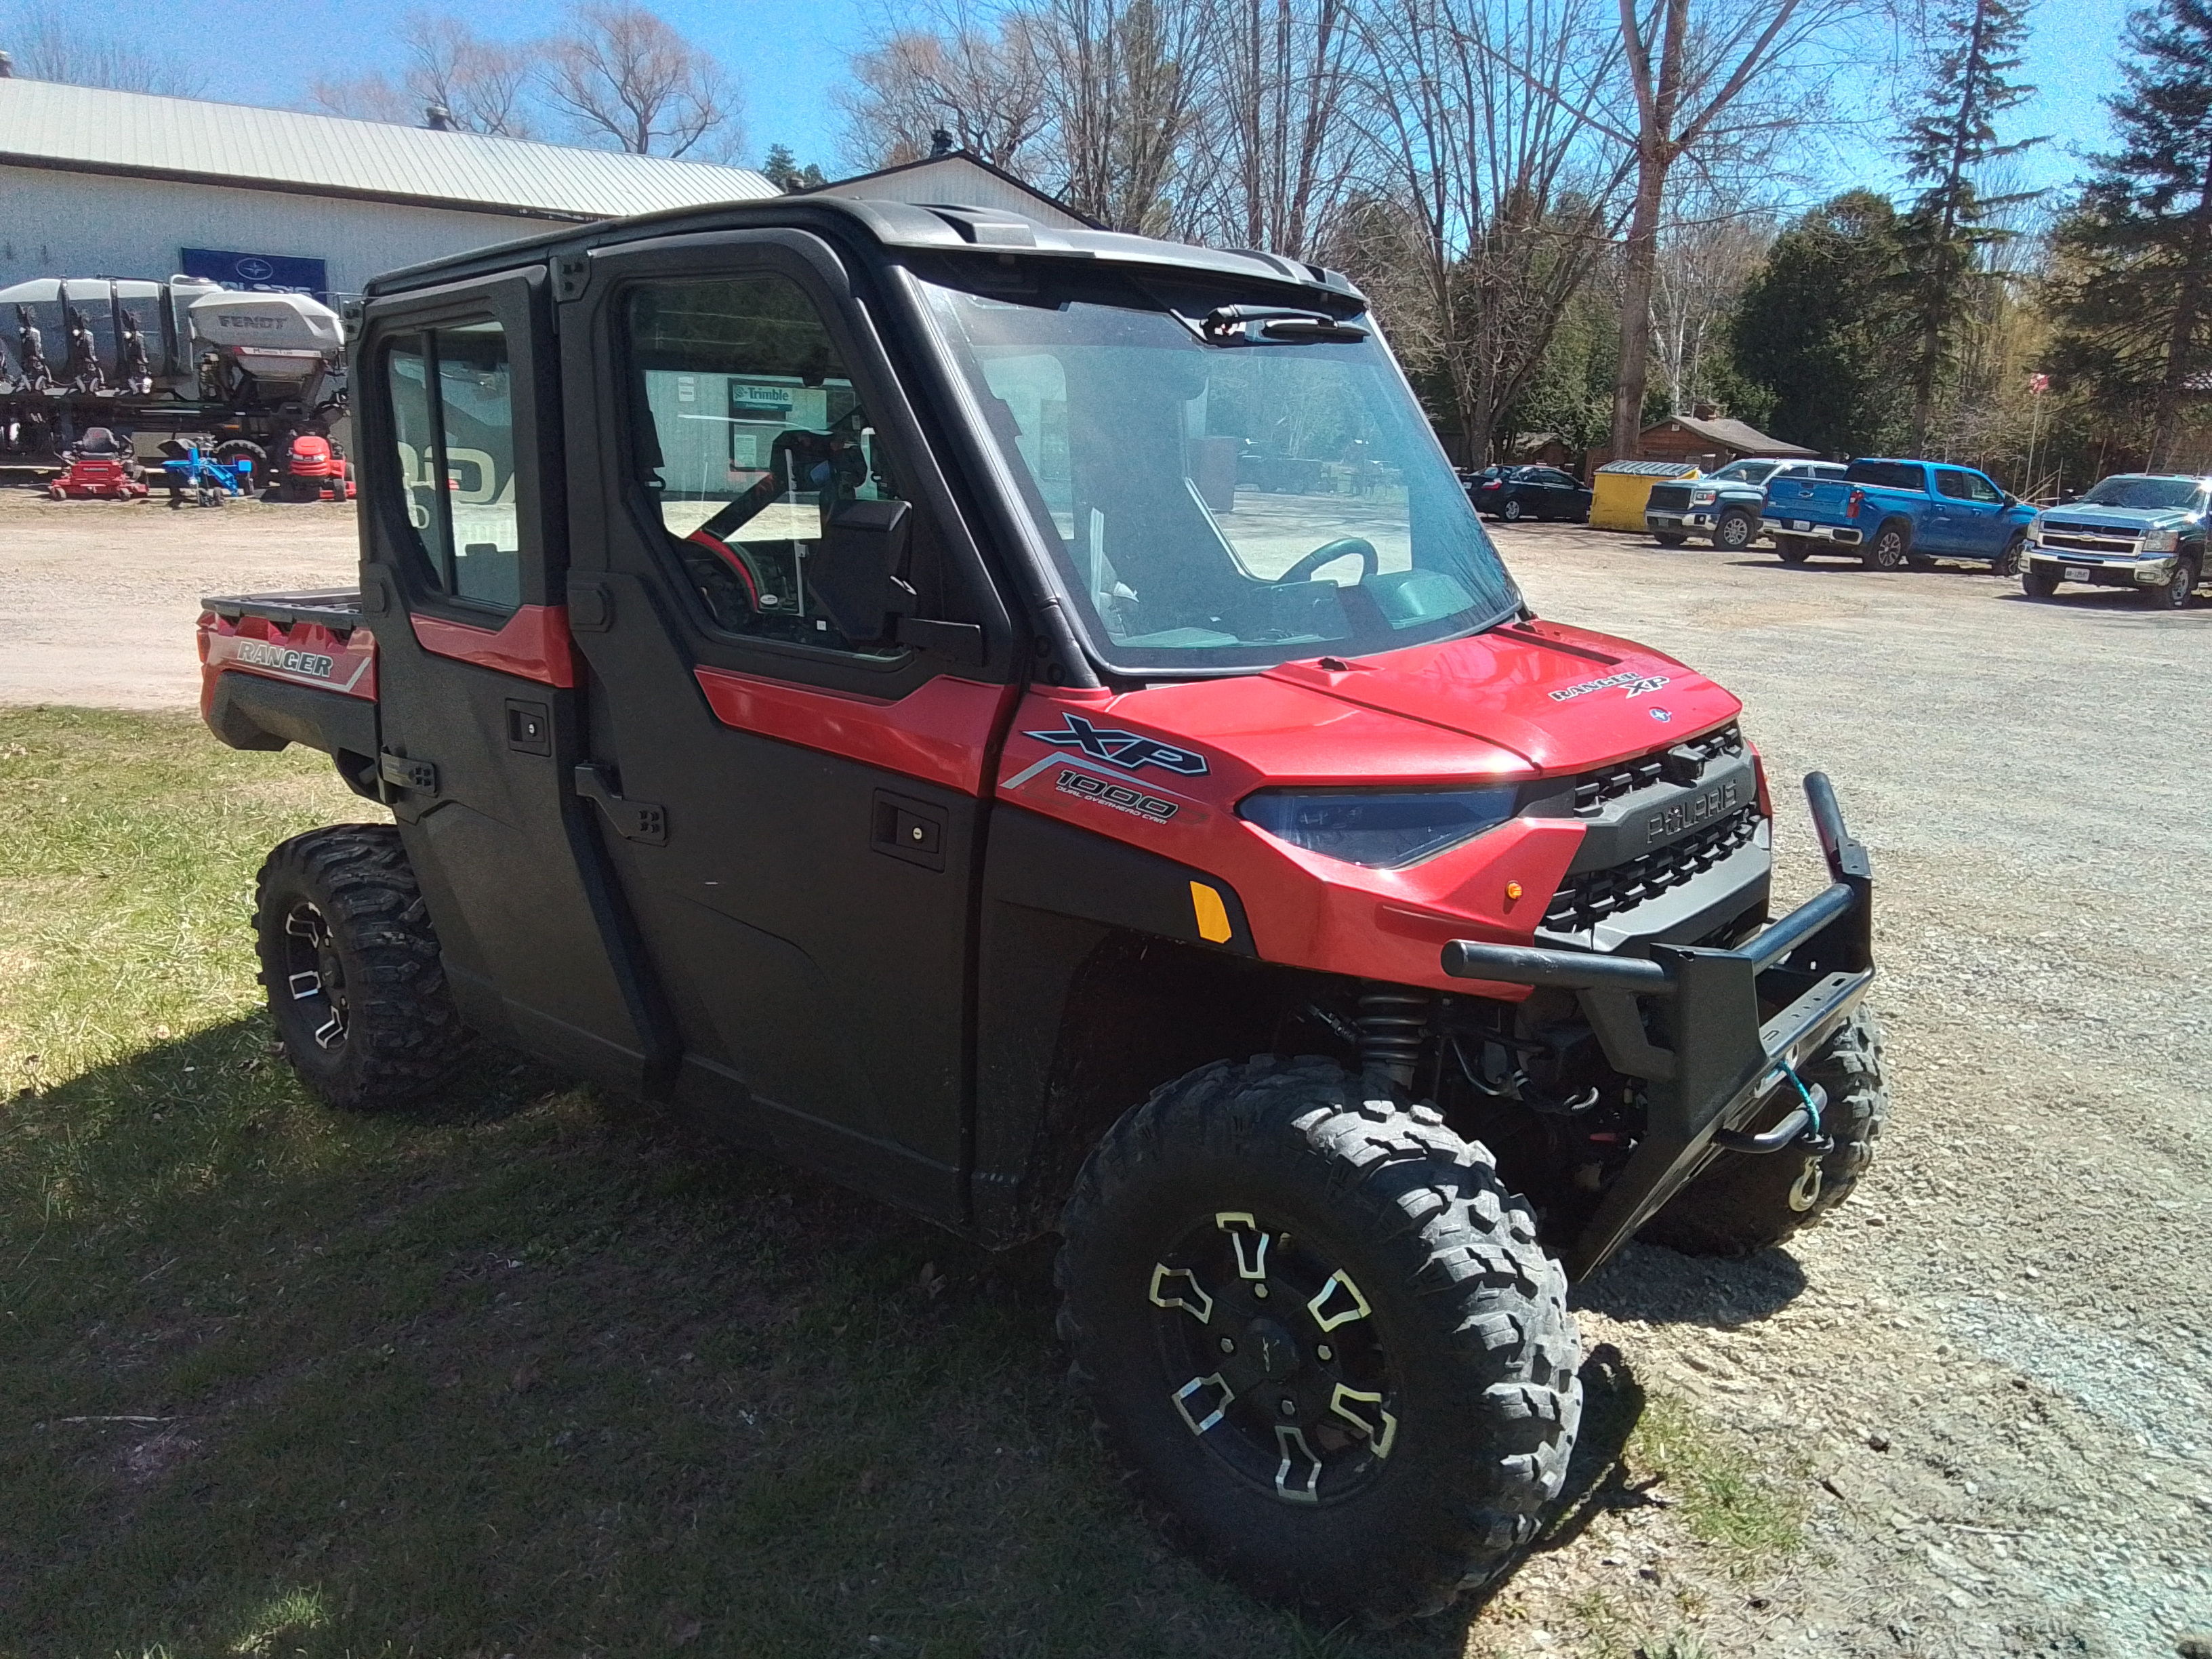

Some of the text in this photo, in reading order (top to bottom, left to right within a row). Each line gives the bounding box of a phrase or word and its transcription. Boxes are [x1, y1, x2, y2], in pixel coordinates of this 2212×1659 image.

[218, 315, 289, 330] FENDT
[747, 387, 789, 401] Trimble
[238, 641, 333, 678] RANGER
[1548, 672, 1643, 701] RANGER
[1618, 676, 1670, 699] XP
[1021, 712, 1211, 775] XP
[1055, 785, 1168, 825] DUAL OVERHEAD CAM
[1056, 769, 1179, 819] 1000
[1647, 779, 1737, 844] POLARIS
